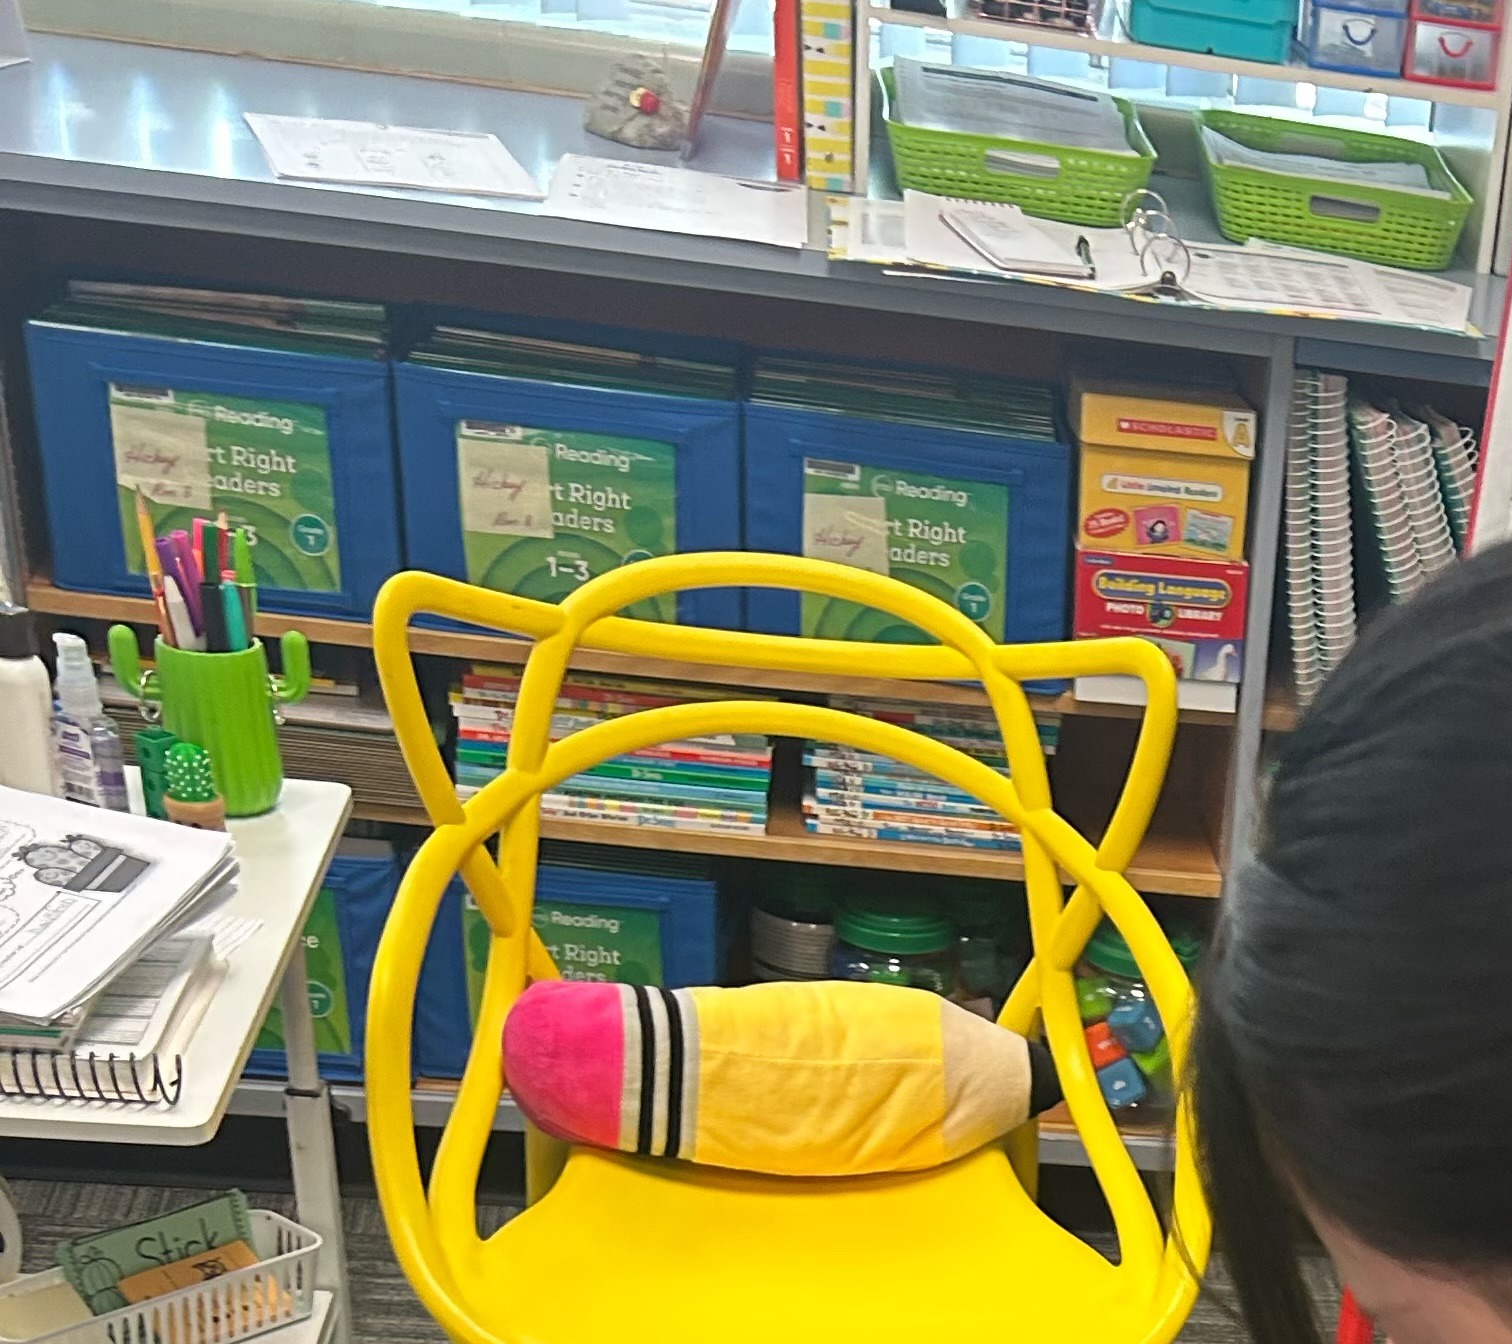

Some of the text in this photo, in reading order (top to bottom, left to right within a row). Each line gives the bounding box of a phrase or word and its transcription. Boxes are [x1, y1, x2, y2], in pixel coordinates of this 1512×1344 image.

[213, 405, 294, 435] Reading
[1233, 422, 1250, 448] A
[230, 445, 297, 474] Right
[555, 443, 630, 473] Reading
[209, 471, 282, 497] aders
[568, 482, 632, 511] Right
[895, 480, 968, 507] Reading
[552, 508, 616, 534] aders
[907, 518, 967, 545] Right
[890, 545, 950, 568] aders
[1099, 576, 1227, 602] Building Language
[1105, 602, 1145, 616] PHOTO
[1177, 608, 1224, 622] LIBRARY
[552, 910, 620, 934] Reading
[564, 944, 621, 966] Right
[563, 965, 608, 982] ders
[136, 1218, 219, 1265] Stick
